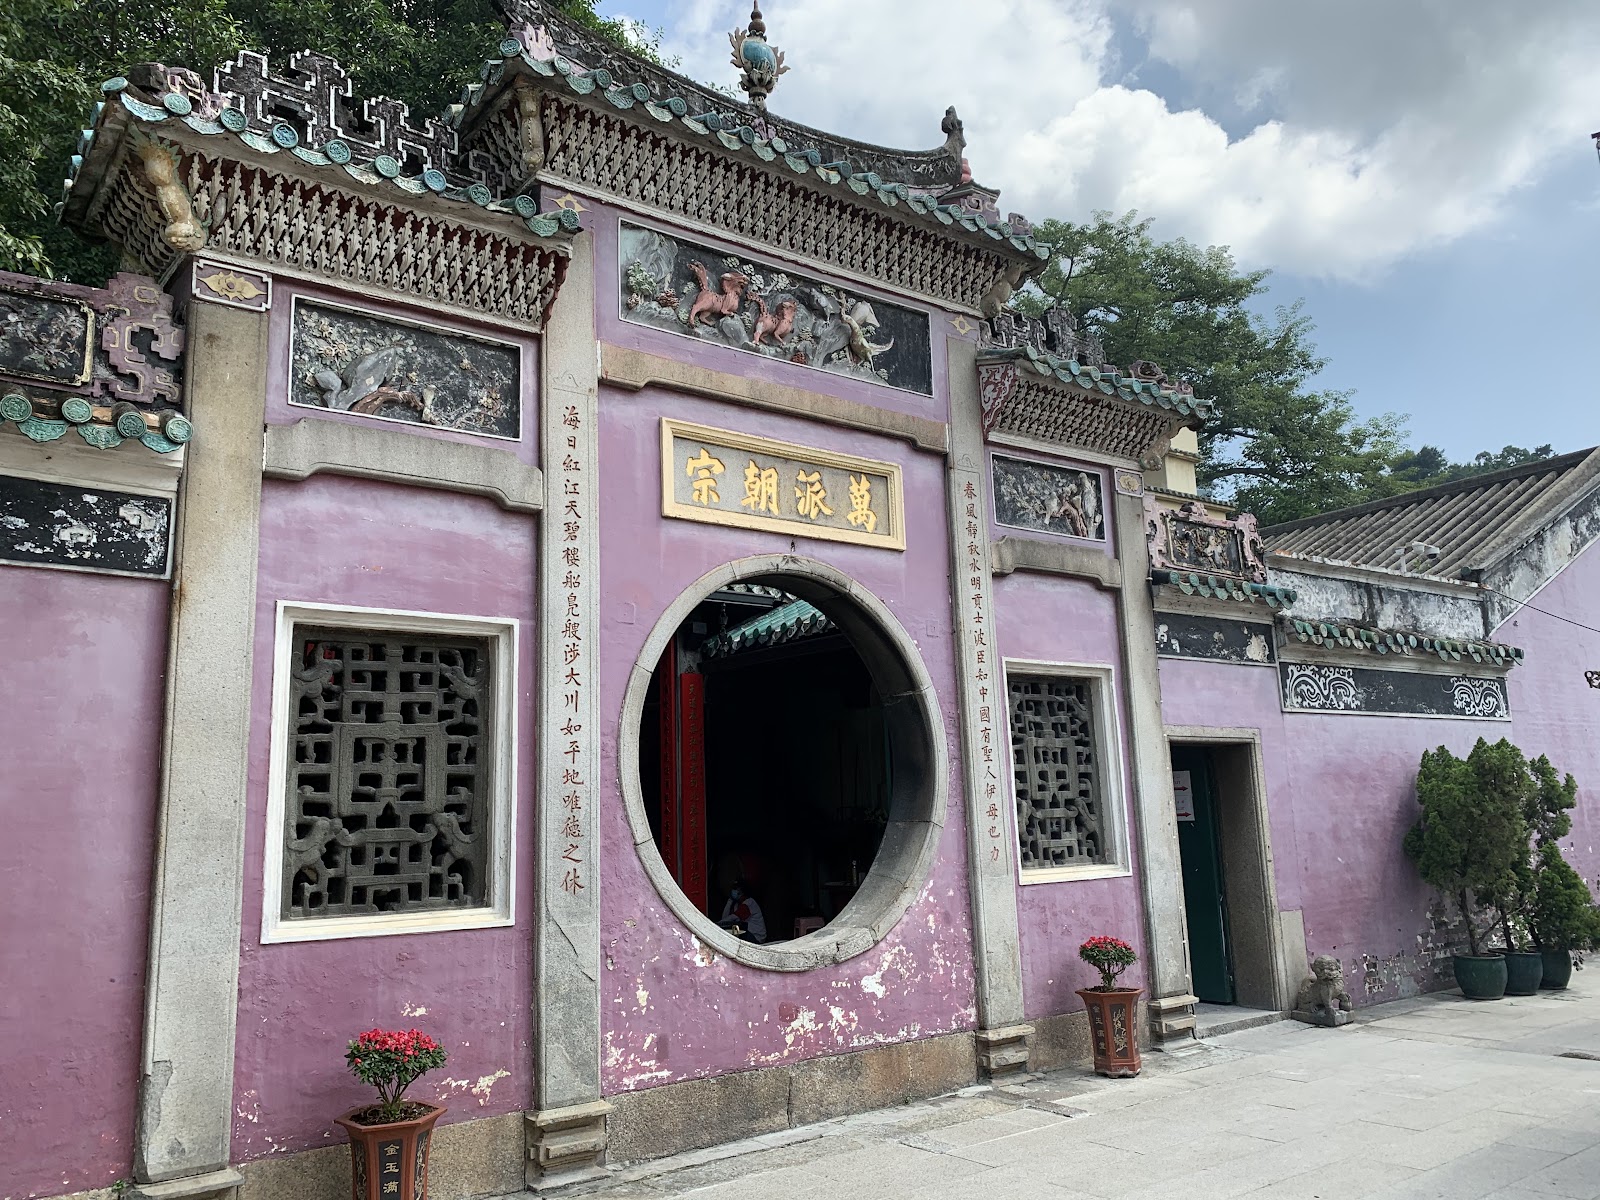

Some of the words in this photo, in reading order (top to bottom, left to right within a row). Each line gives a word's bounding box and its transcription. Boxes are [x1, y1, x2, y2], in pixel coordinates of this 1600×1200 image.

[685, 447, 878, 533] 萬派朝宗
[383, 1143, 400, 1193] 金玉滿
